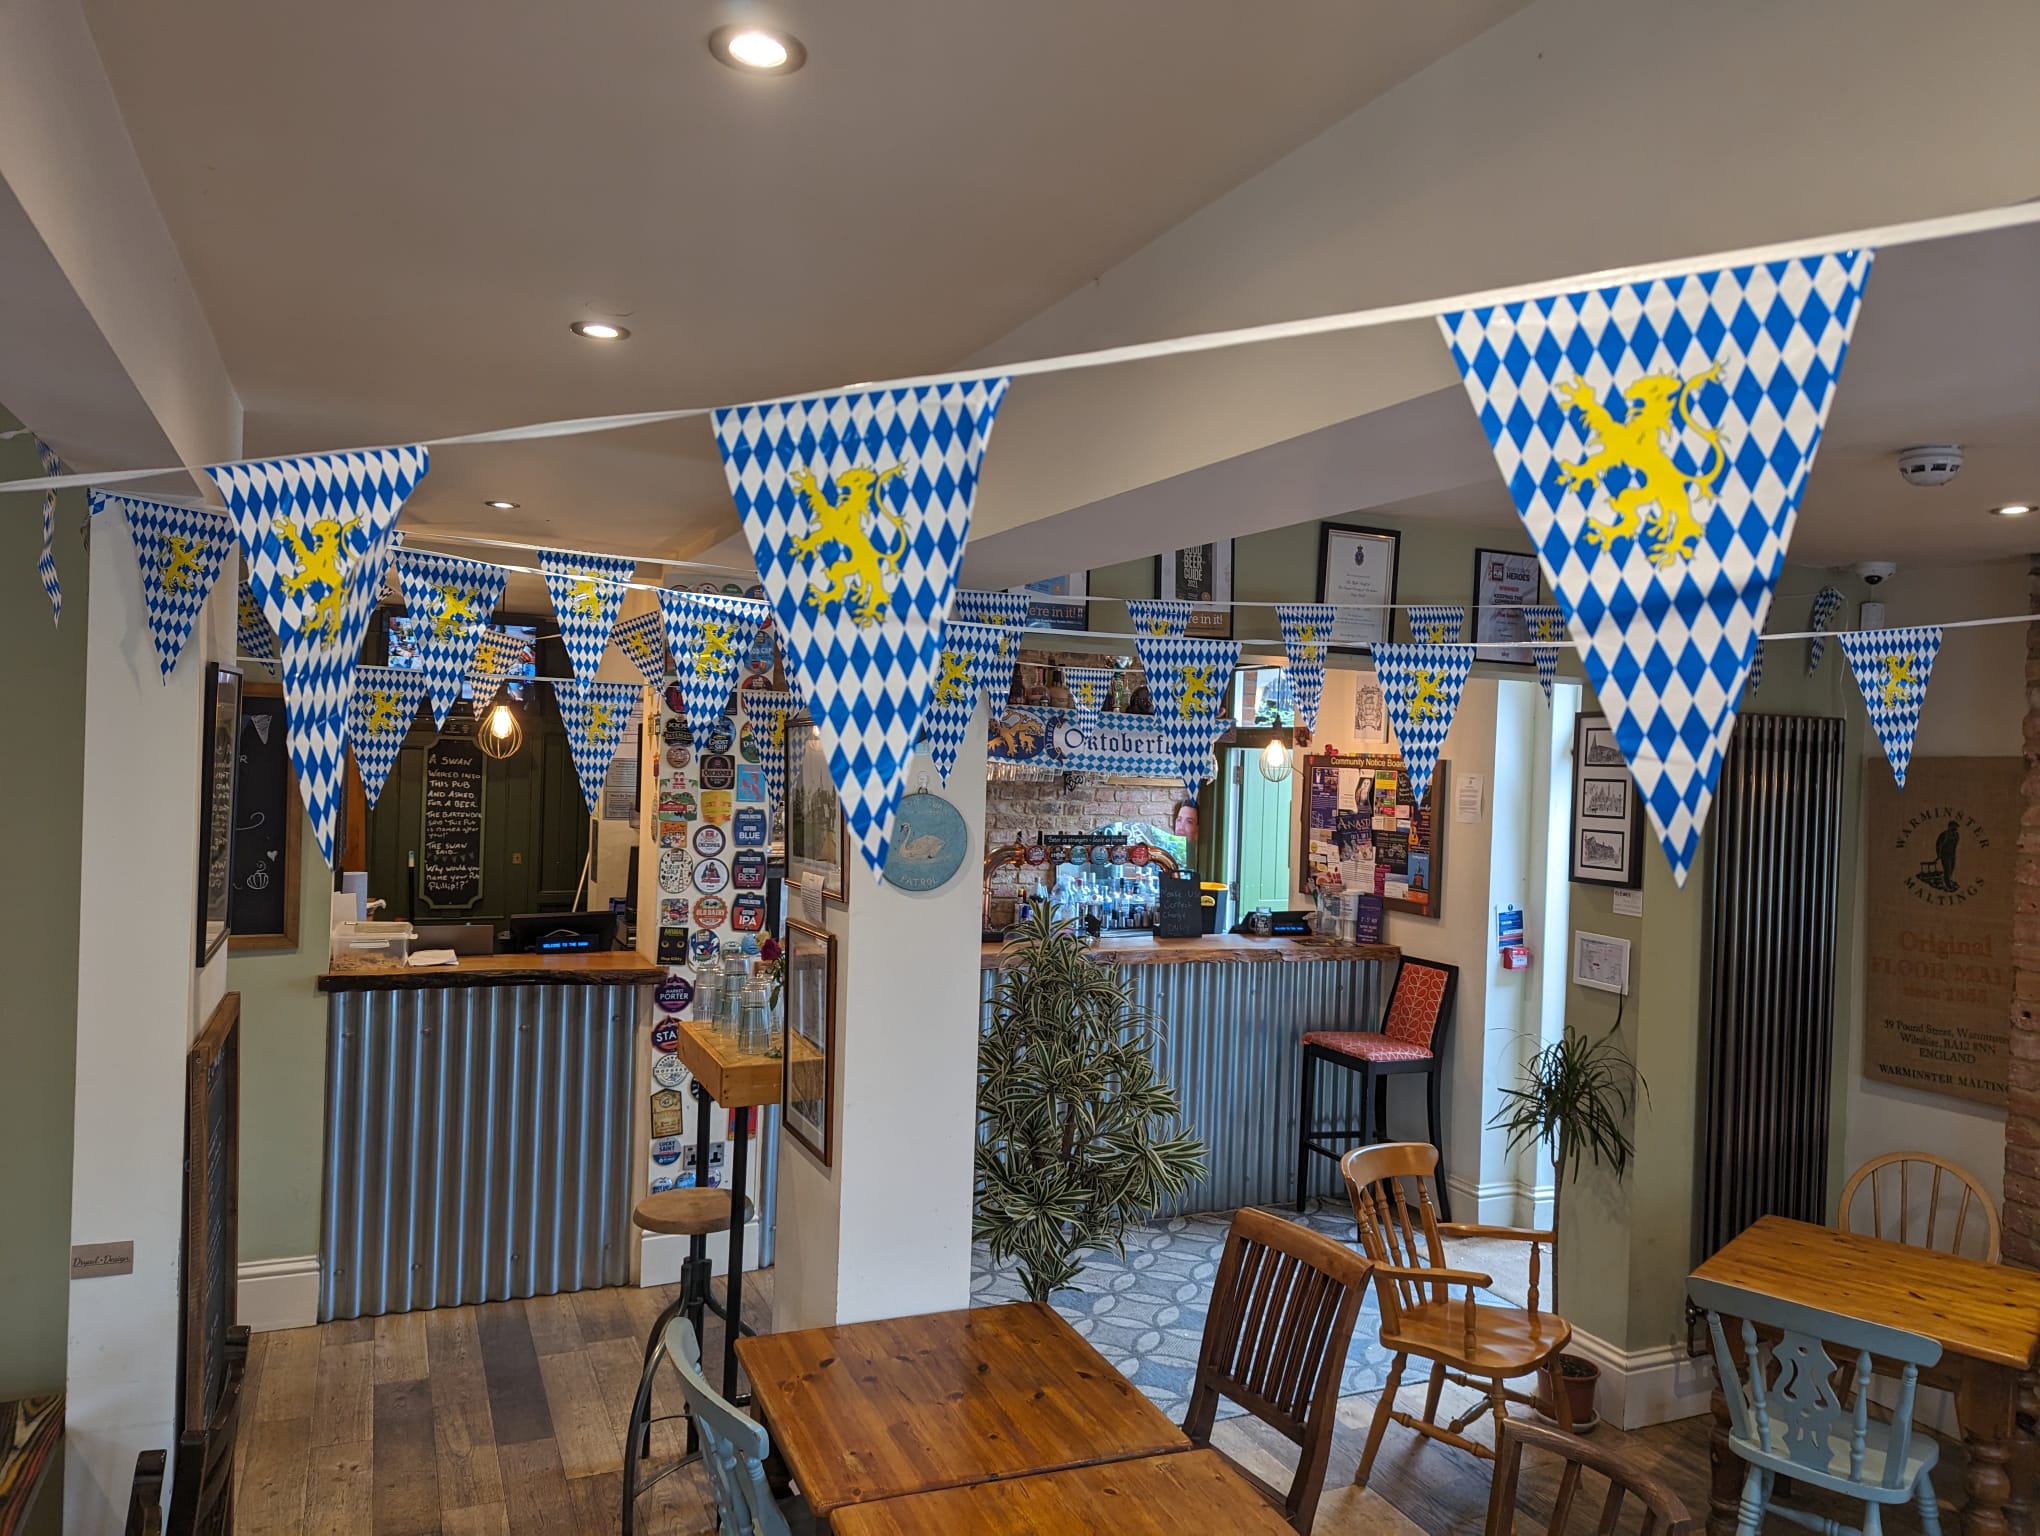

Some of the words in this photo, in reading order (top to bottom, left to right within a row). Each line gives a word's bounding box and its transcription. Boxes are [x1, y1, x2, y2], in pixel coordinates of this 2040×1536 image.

[1184, 555, 1202, 569] BEER
[1184, 568, 1202, 581] GUIDE
[1506, 572, 1530, 581] HEROES
[1028, 607, 1050, 617] e're
[1052, 606, 1063, 617] in
[1200, 614, 1212, 624] in
[1213, 614, 1223, 625] it!
[441, 757, 472, 766] SWAN
[1331, 757, 1364, 767] Community
[1366, 758, 1386, 767] Notice
[452, 781, 470, 789] PUB
[426, 810, 440, 818] THE
[1895, 806, 1990, 850] WARMINSTER
[739, 832, 761, 840] BLUE
[426, 841, 441, 849] THE
[738, 874, 761, 882] BEST
[1903, 875, 1985, 907] MALTINGS
[739, 916, 757, 925] IPA
[1899, 930, 1993, 960] Original
[1871, 956, 1946, 983] FLOOR
[1897, 1020, 1925, 1034] Pound
[656, 1031, 678, 1042] STA
[1919, 1047, 1976, 1065] ENGLAND
[1879, 1063, 1953, 1084] WARMINSTER
